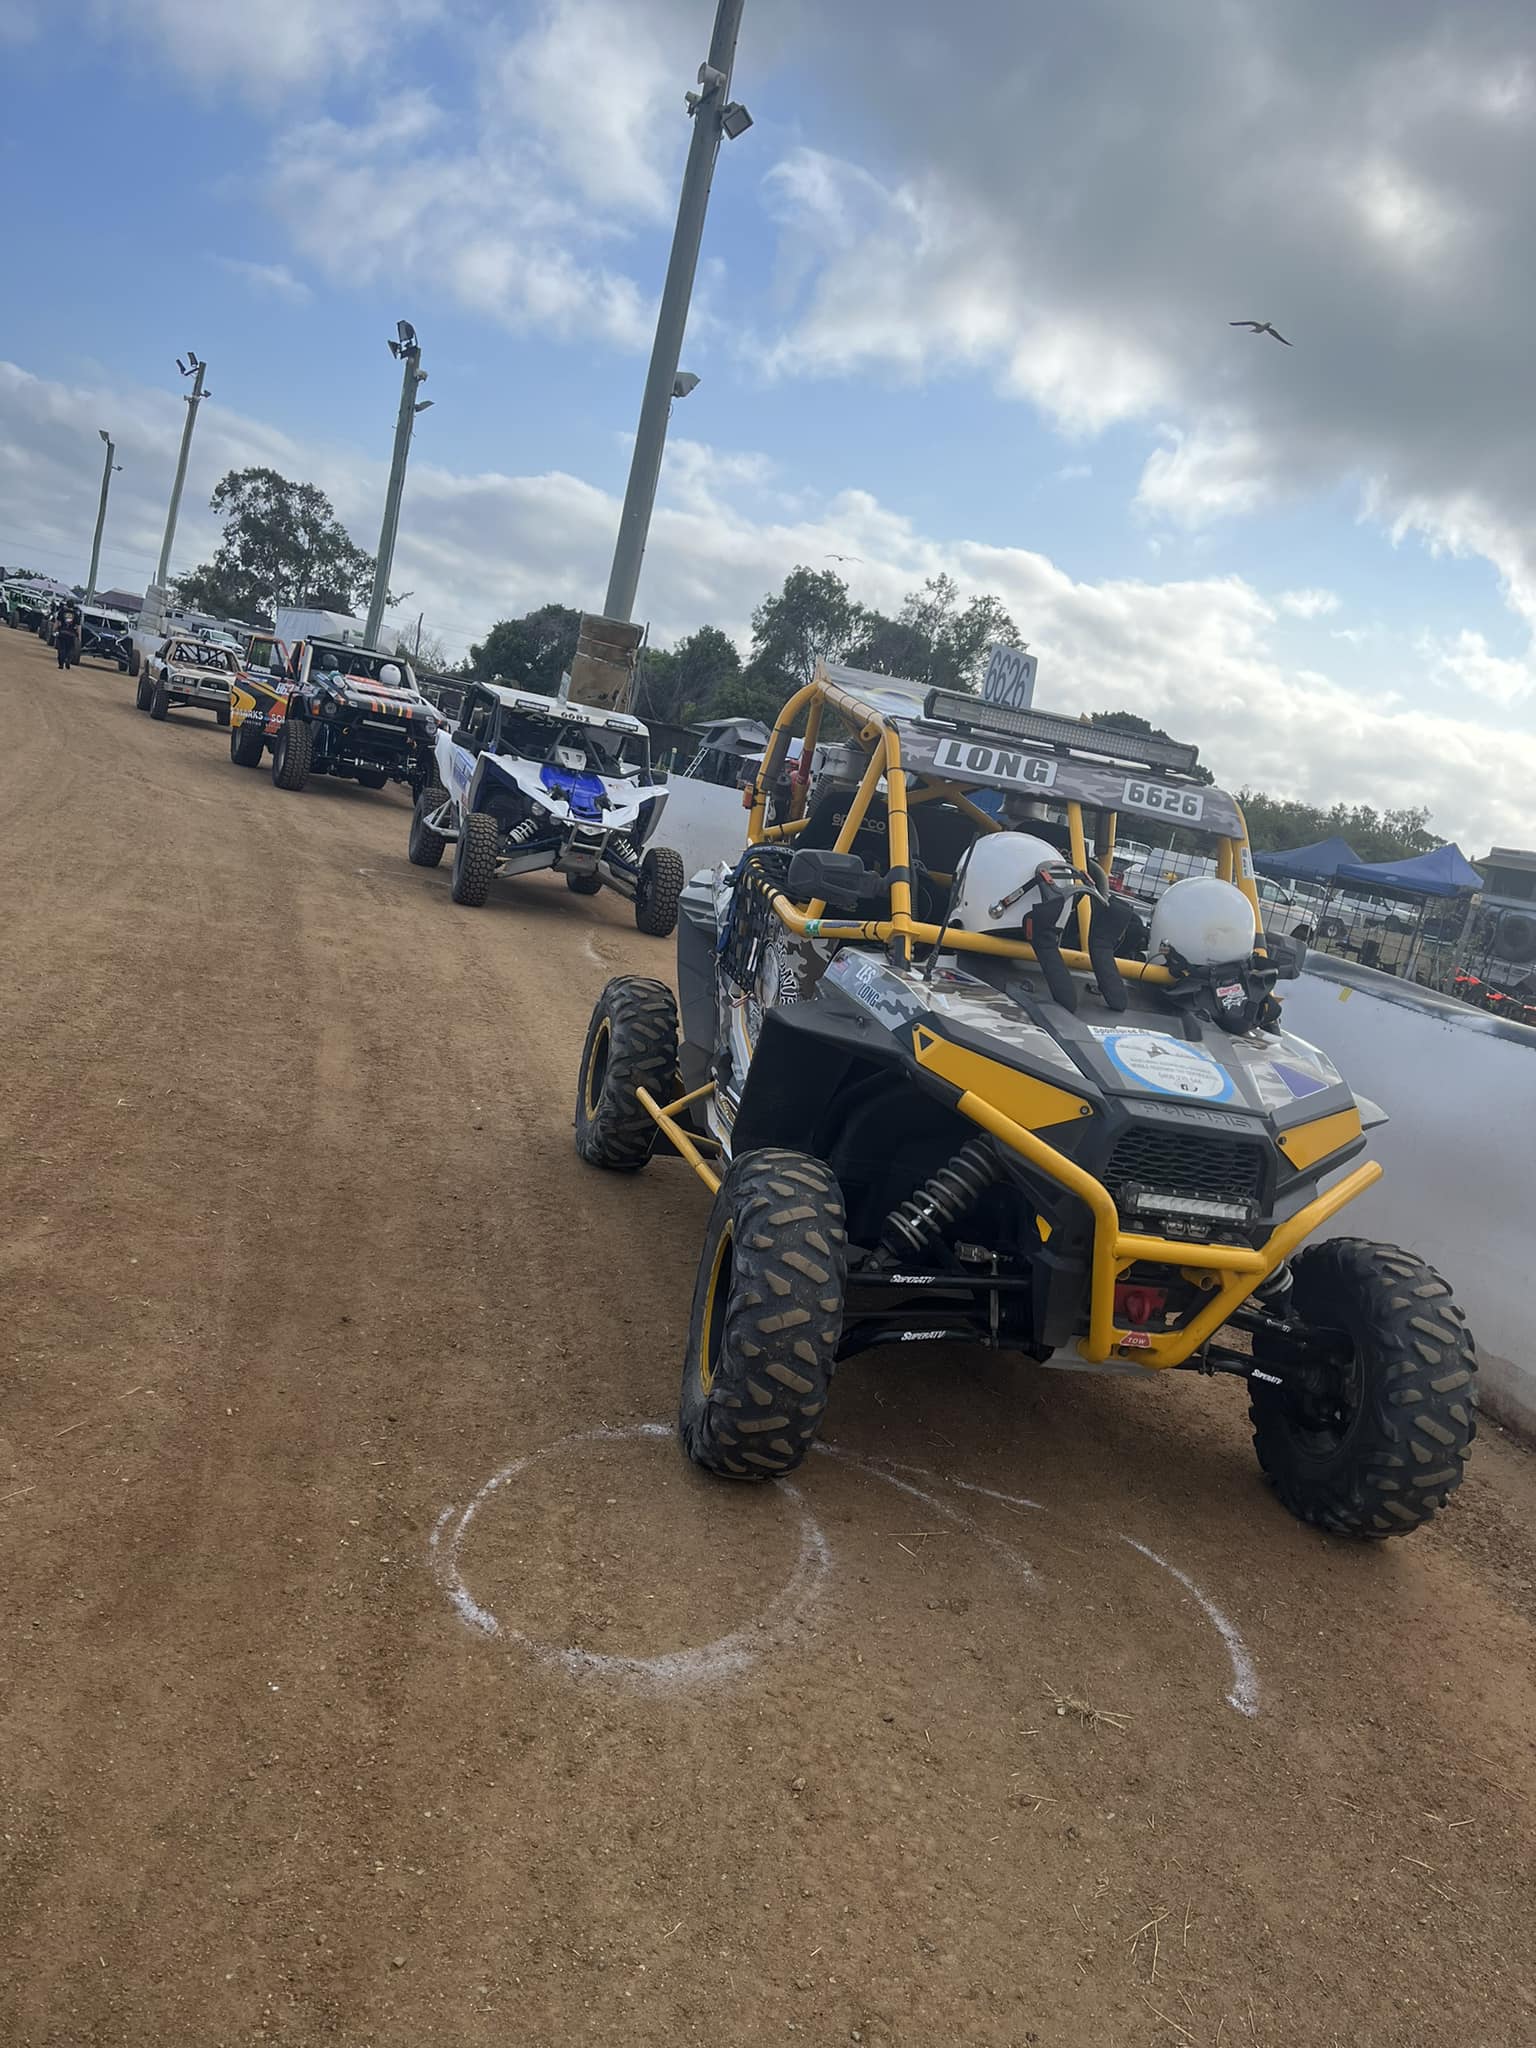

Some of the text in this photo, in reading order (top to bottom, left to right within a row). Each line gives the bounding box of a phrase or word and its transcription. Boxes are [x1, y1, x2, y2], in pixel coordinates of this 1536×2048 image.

[984, 650, 1030, 707] 6626
[944, 743, 1050, 785] LONG
[1128, 782, 1198, 816] 6626
[857, 984, 880, 1008] LONG
[1140, 1102, 1252, 1129] POLARIS
[1128, 1337, 1146, 1345] TOW
